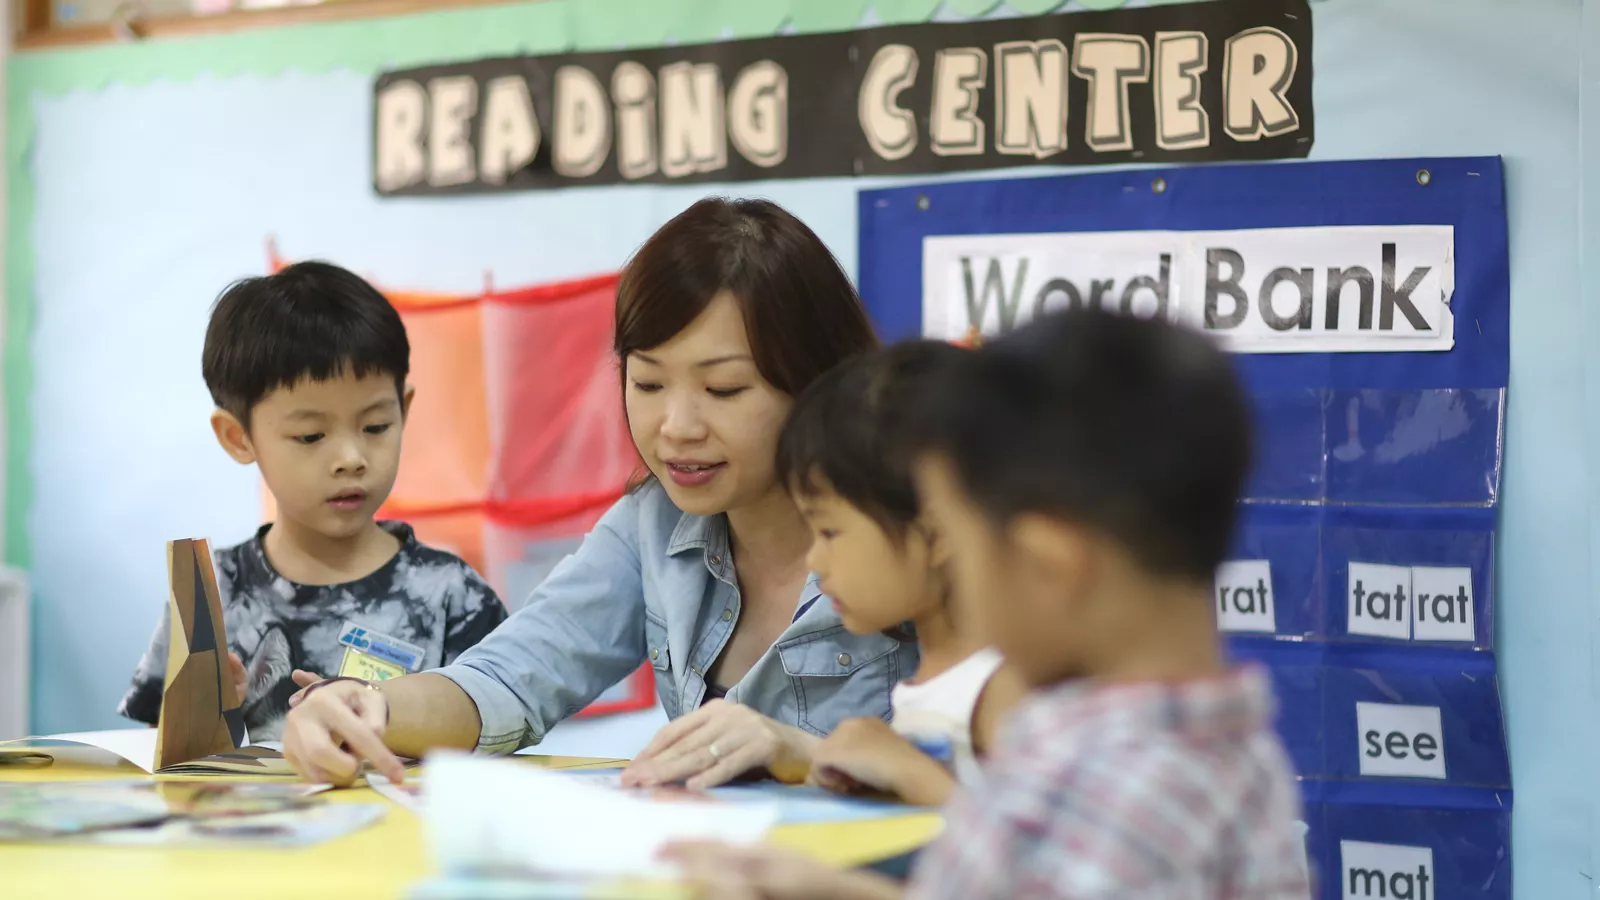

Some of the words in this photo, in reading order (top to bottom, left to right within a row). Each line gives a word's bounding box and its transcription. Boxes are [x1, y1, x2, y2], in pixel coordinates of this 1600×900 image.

[858, 26, 1299, 160] CENTER
[960, 253, 1172, 332] Word
[1204, 243, 1432, 331] Bank
[1219, 578, 1268, 615] rat
[1353, 580, 1406, 621] tat
[1418, 585, 1468, 623] rat
[1365, 729, 1437, 760] see
[1349, 865, 1429, 900] mat
